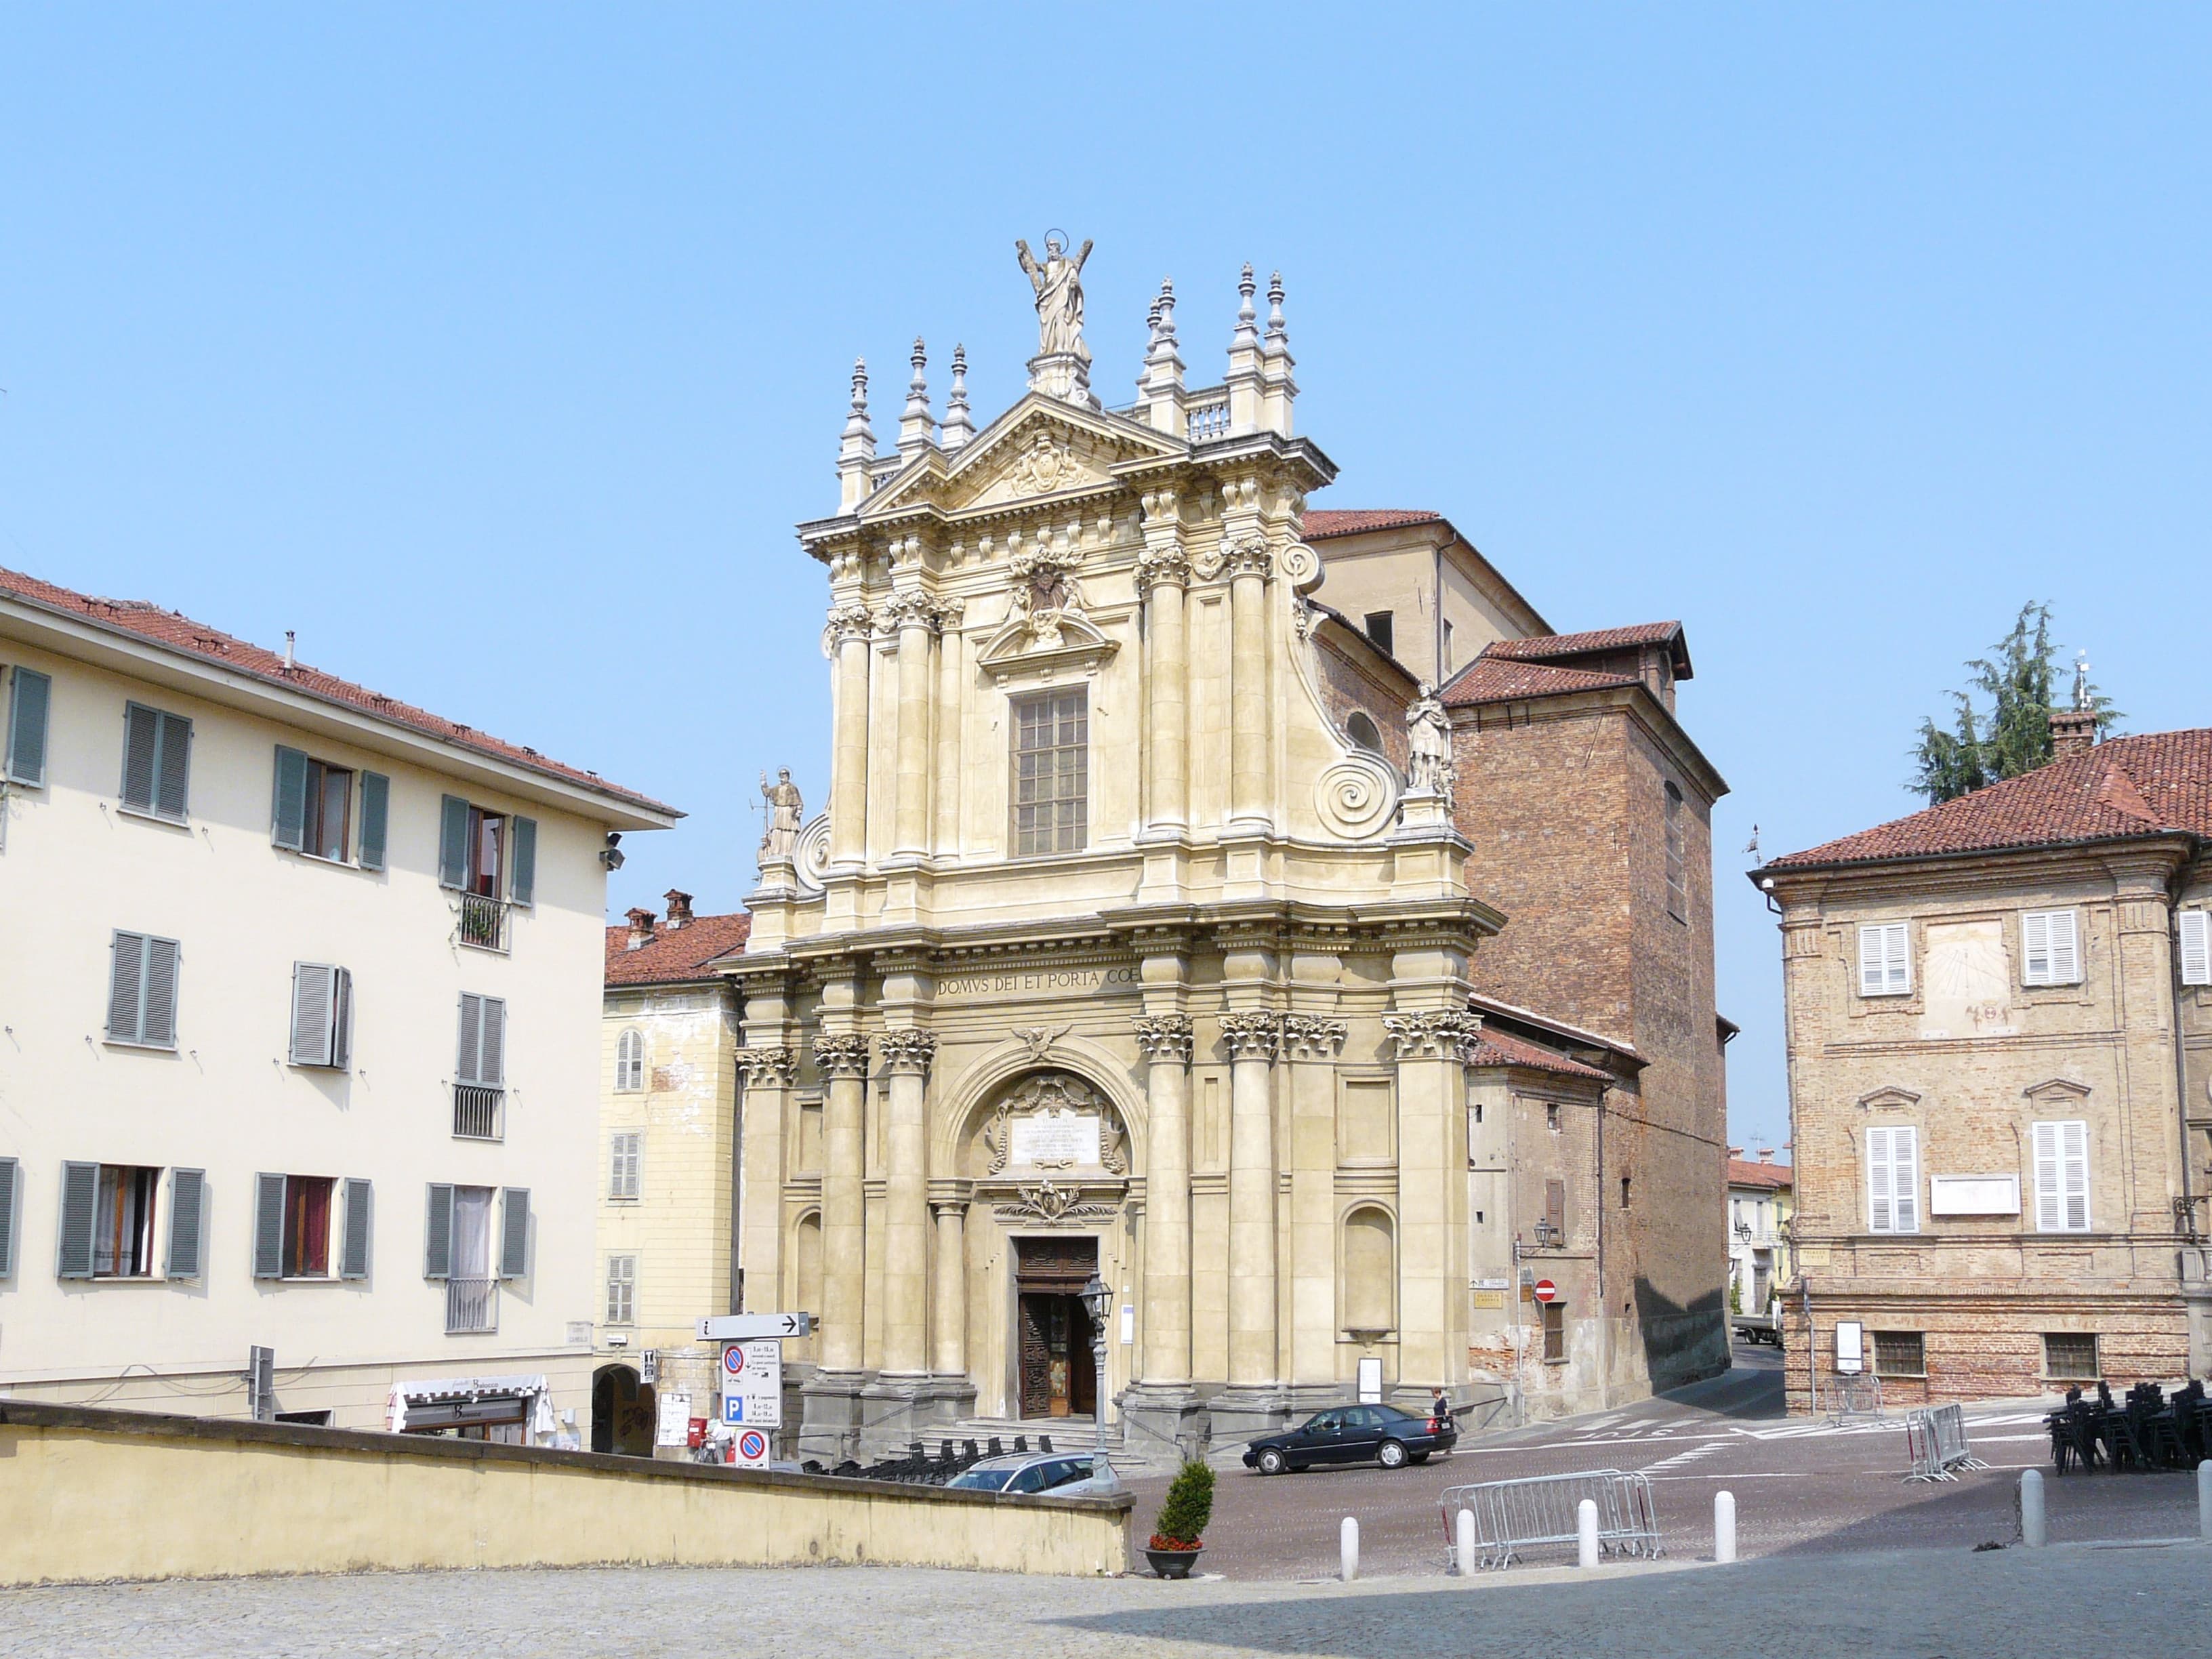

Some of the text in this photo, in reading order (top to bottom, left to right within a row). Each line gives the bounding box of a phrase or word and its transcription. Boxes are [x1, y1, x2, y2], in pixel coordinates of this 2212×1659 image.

[938, 967, 1143, 996] DOMVS DEI ET PORTA COE
[729, 1399, 739, 1418] P
